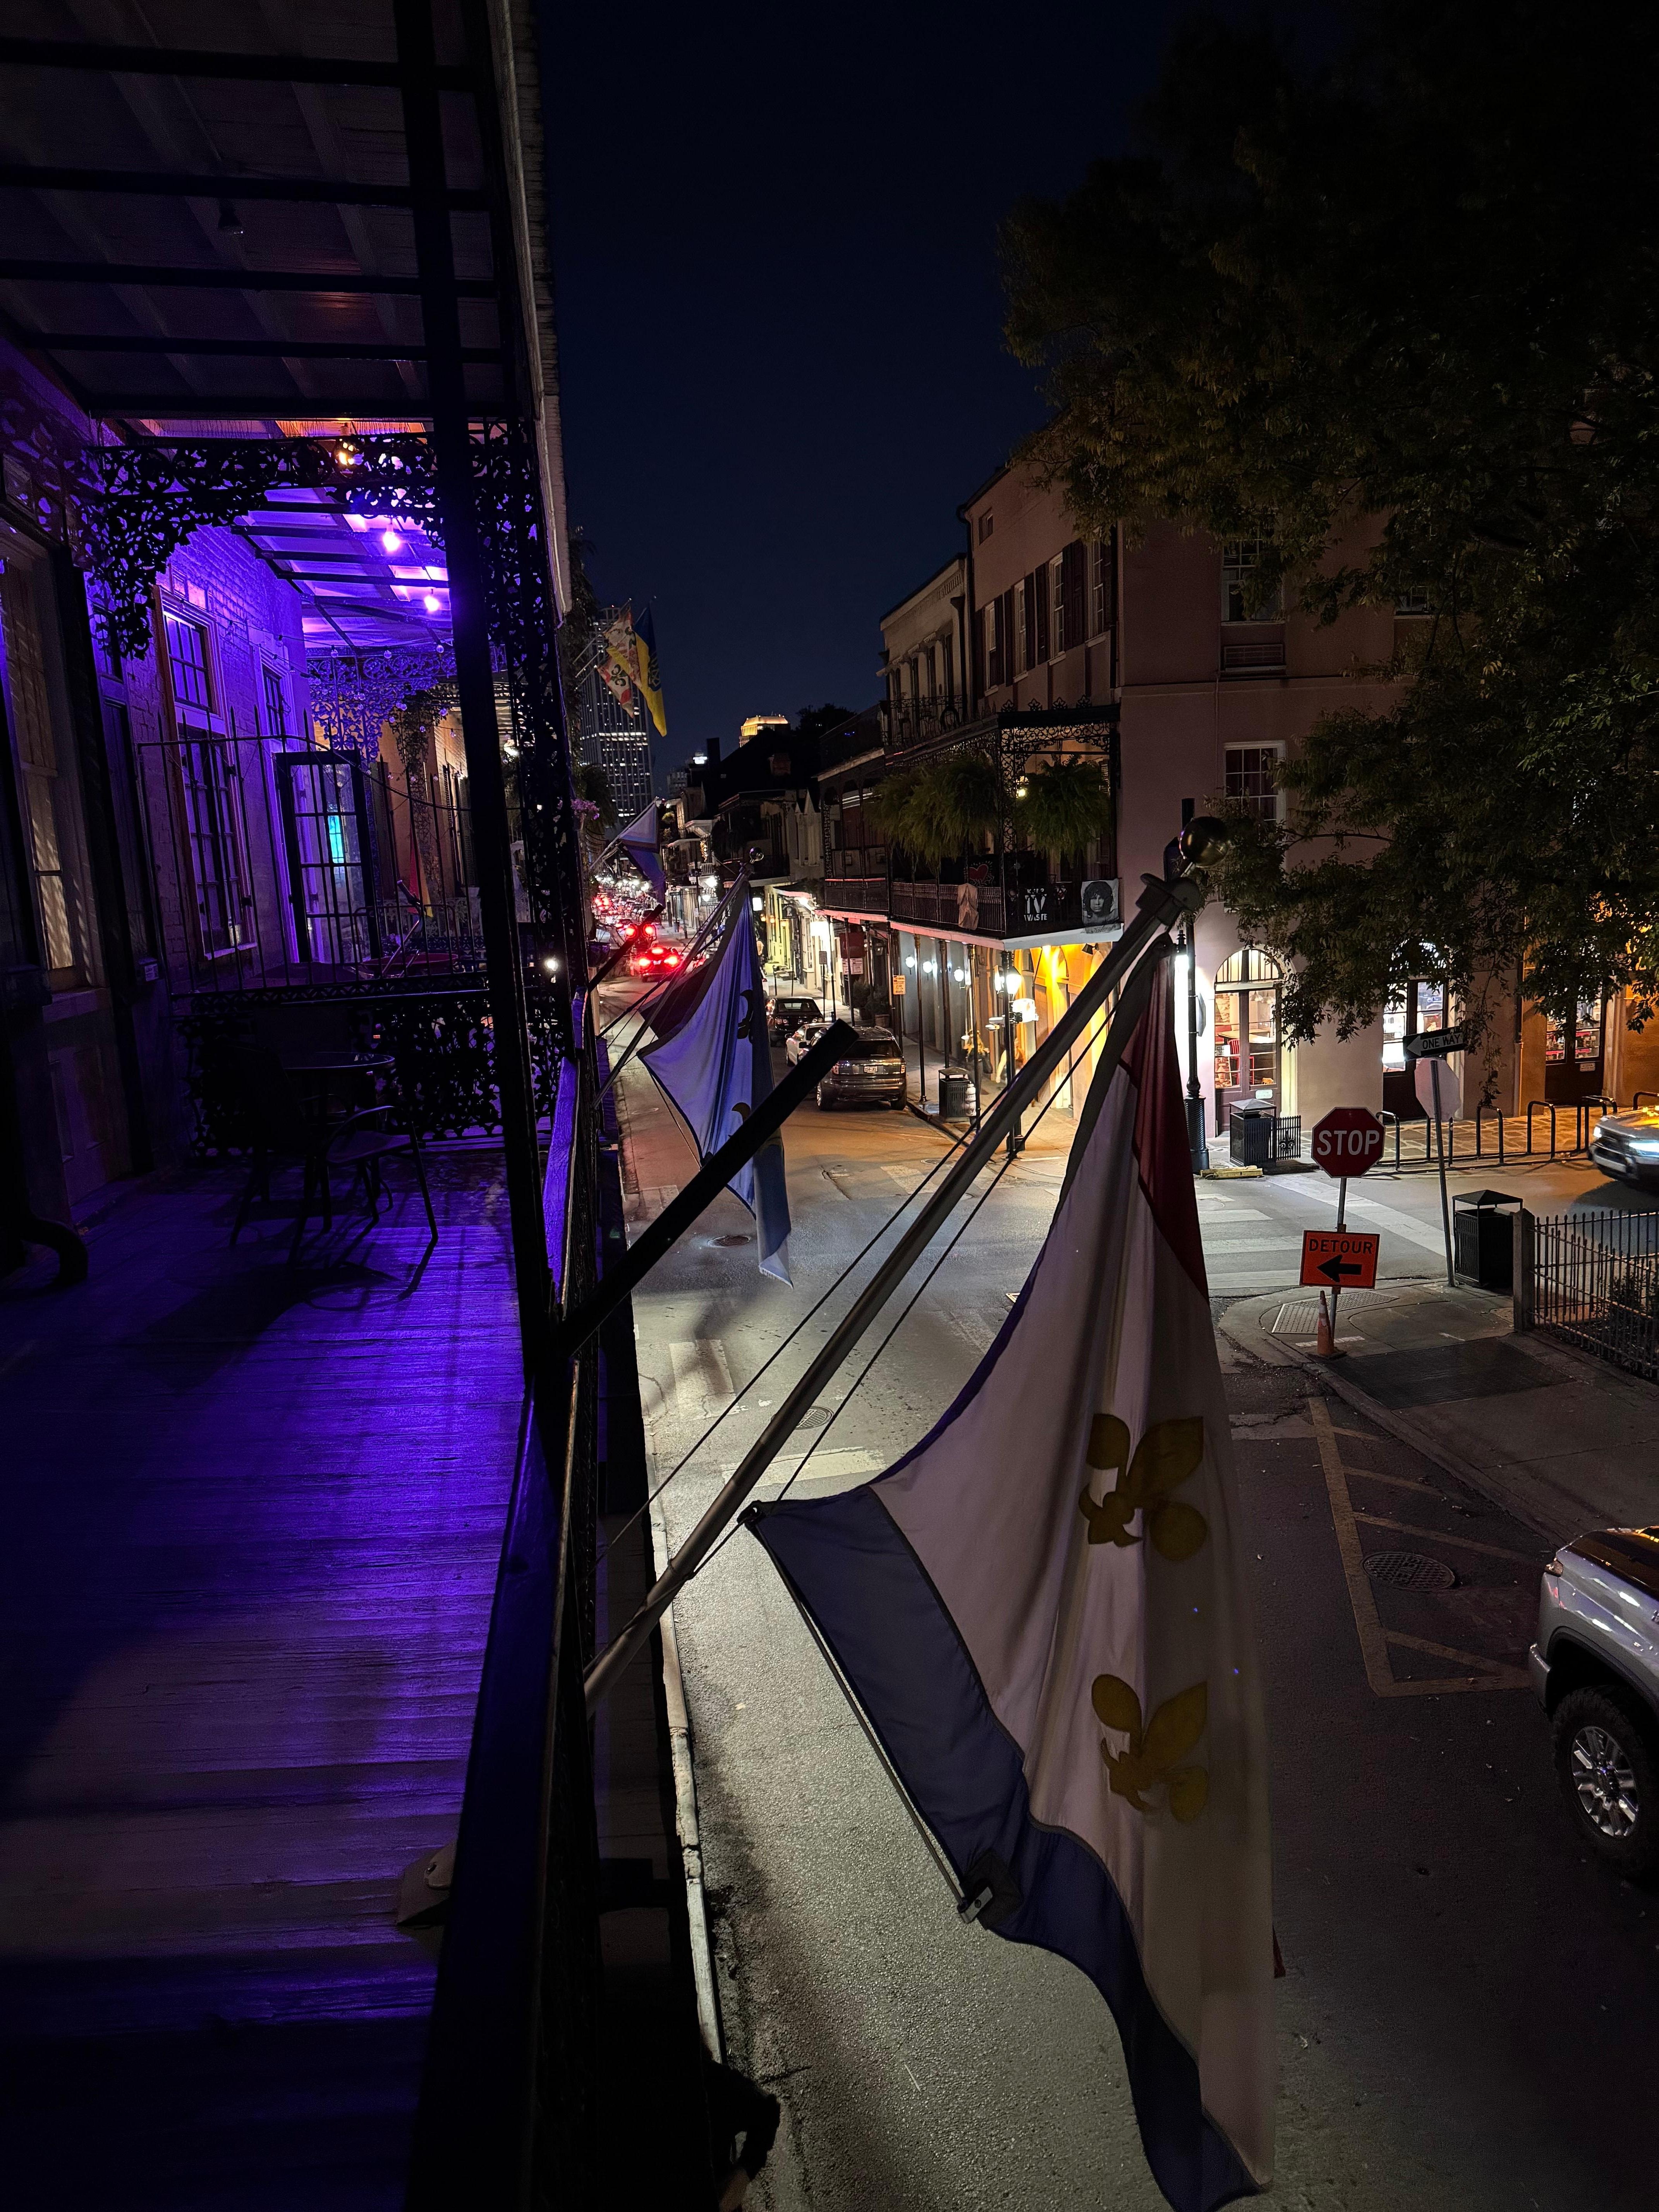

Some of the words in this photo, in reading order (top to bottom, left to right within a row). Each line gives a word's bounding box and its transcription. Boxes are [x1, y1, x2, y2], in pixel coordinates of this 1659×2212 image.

[1422, 1037, 1440, 1049] ONE
[1443, 1034, 1460, 1046] WAY
[1317, 1130, 1380, 1156] STOP
[1309, 1238, 1373, 1254] DETOUR
